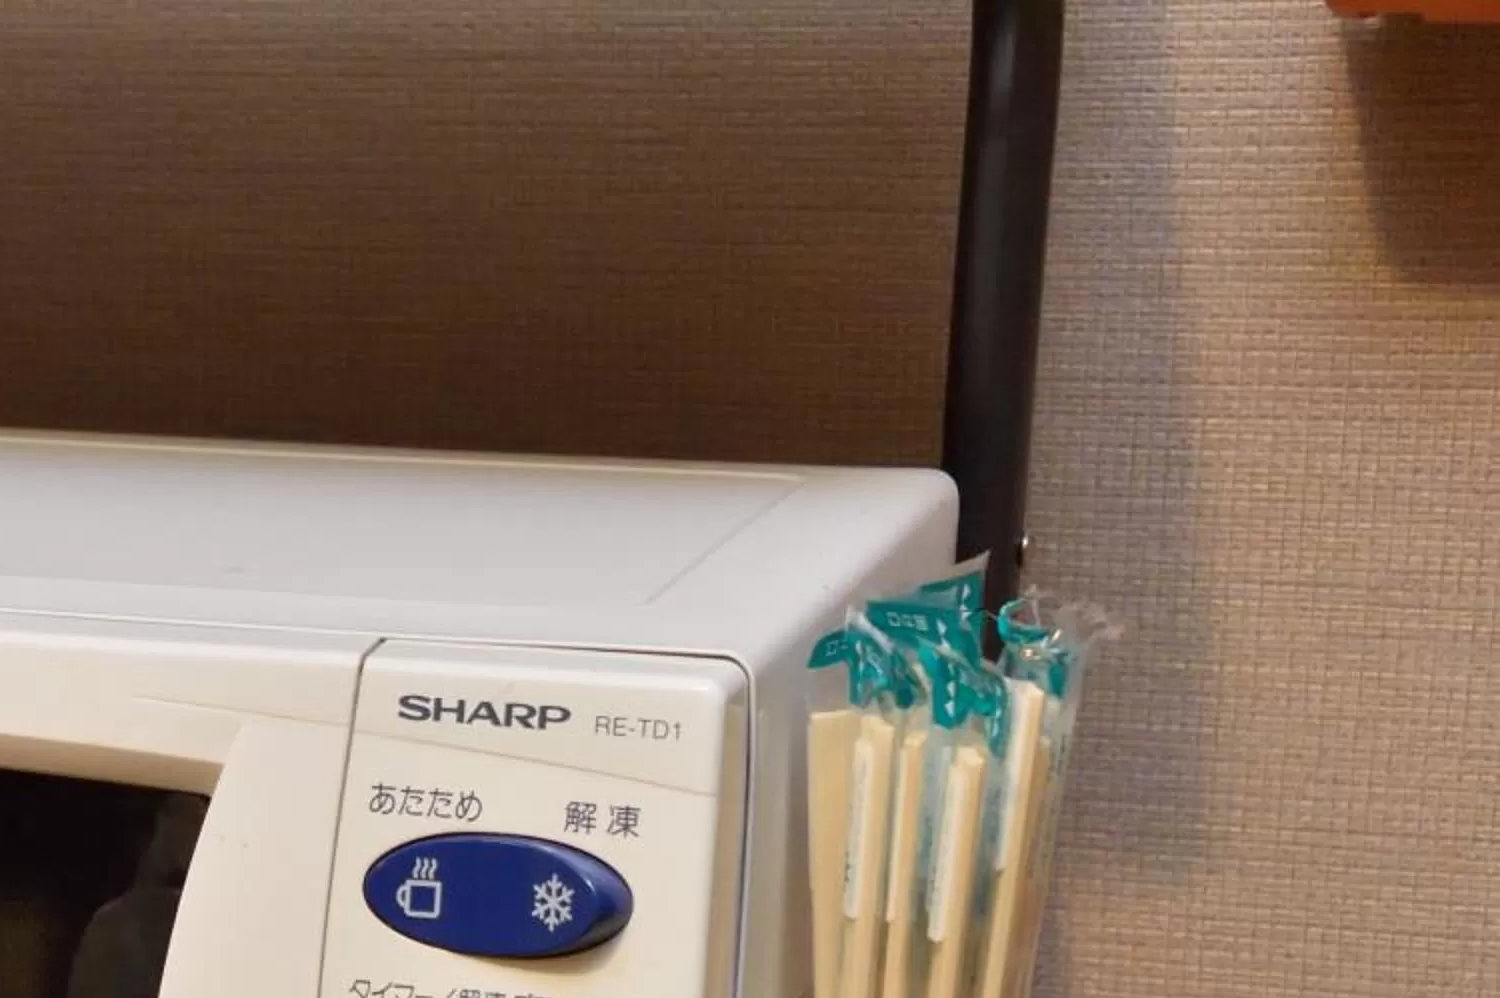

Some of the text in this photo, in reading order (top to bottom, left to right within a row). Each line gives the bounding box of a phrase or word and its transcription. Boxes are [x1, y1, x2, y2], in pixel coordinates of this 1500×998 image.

[397, 695, 571, 729] SHARP
[594, 716, 682, 742] RE-TD1
[368, 783, 483, 822] あたため
[563, 801, 642, 838] 解凍
